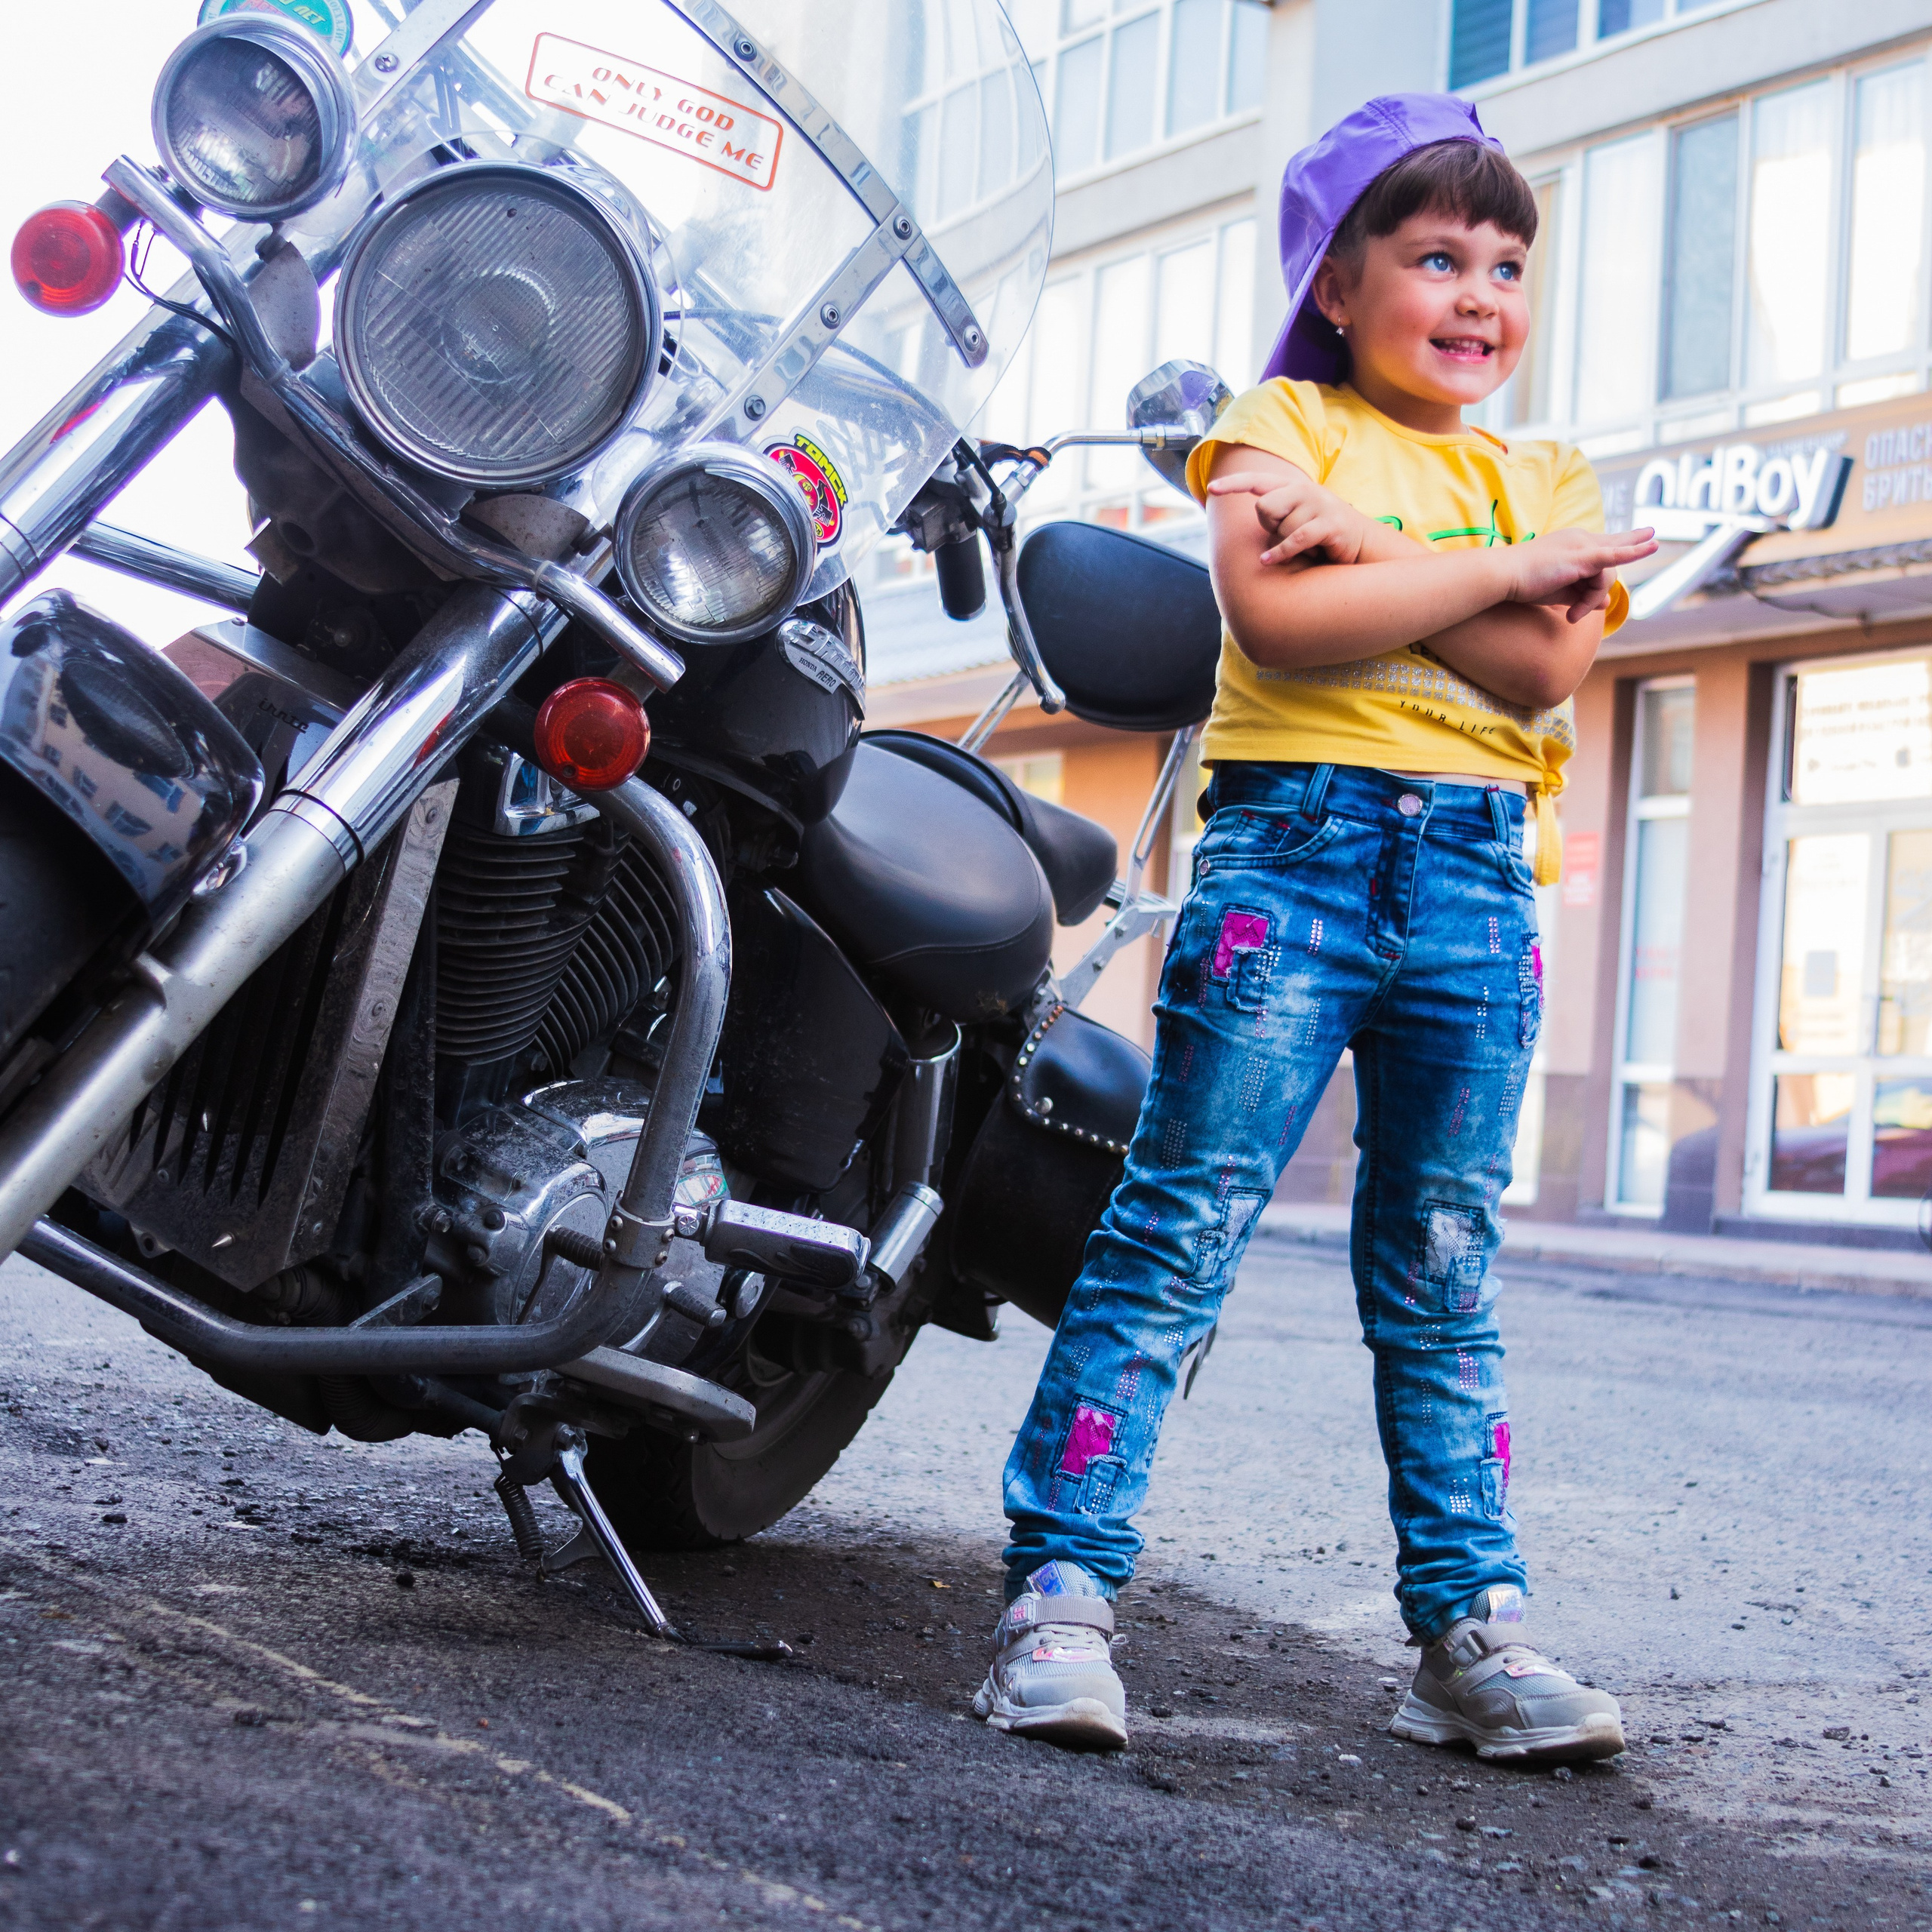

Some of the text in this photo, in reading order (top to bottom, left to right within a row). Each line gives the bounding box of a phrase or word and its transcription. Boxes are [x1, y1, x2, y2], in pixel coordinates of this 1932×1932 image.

[543, 74, 764, 171] CAN JUDGE ME
[592, 67, 734, 131] ONLY GOD
[798, 657, 837, 688] HONDA AERO
[1400, 700, 1497, 735] YOUR LIFE
